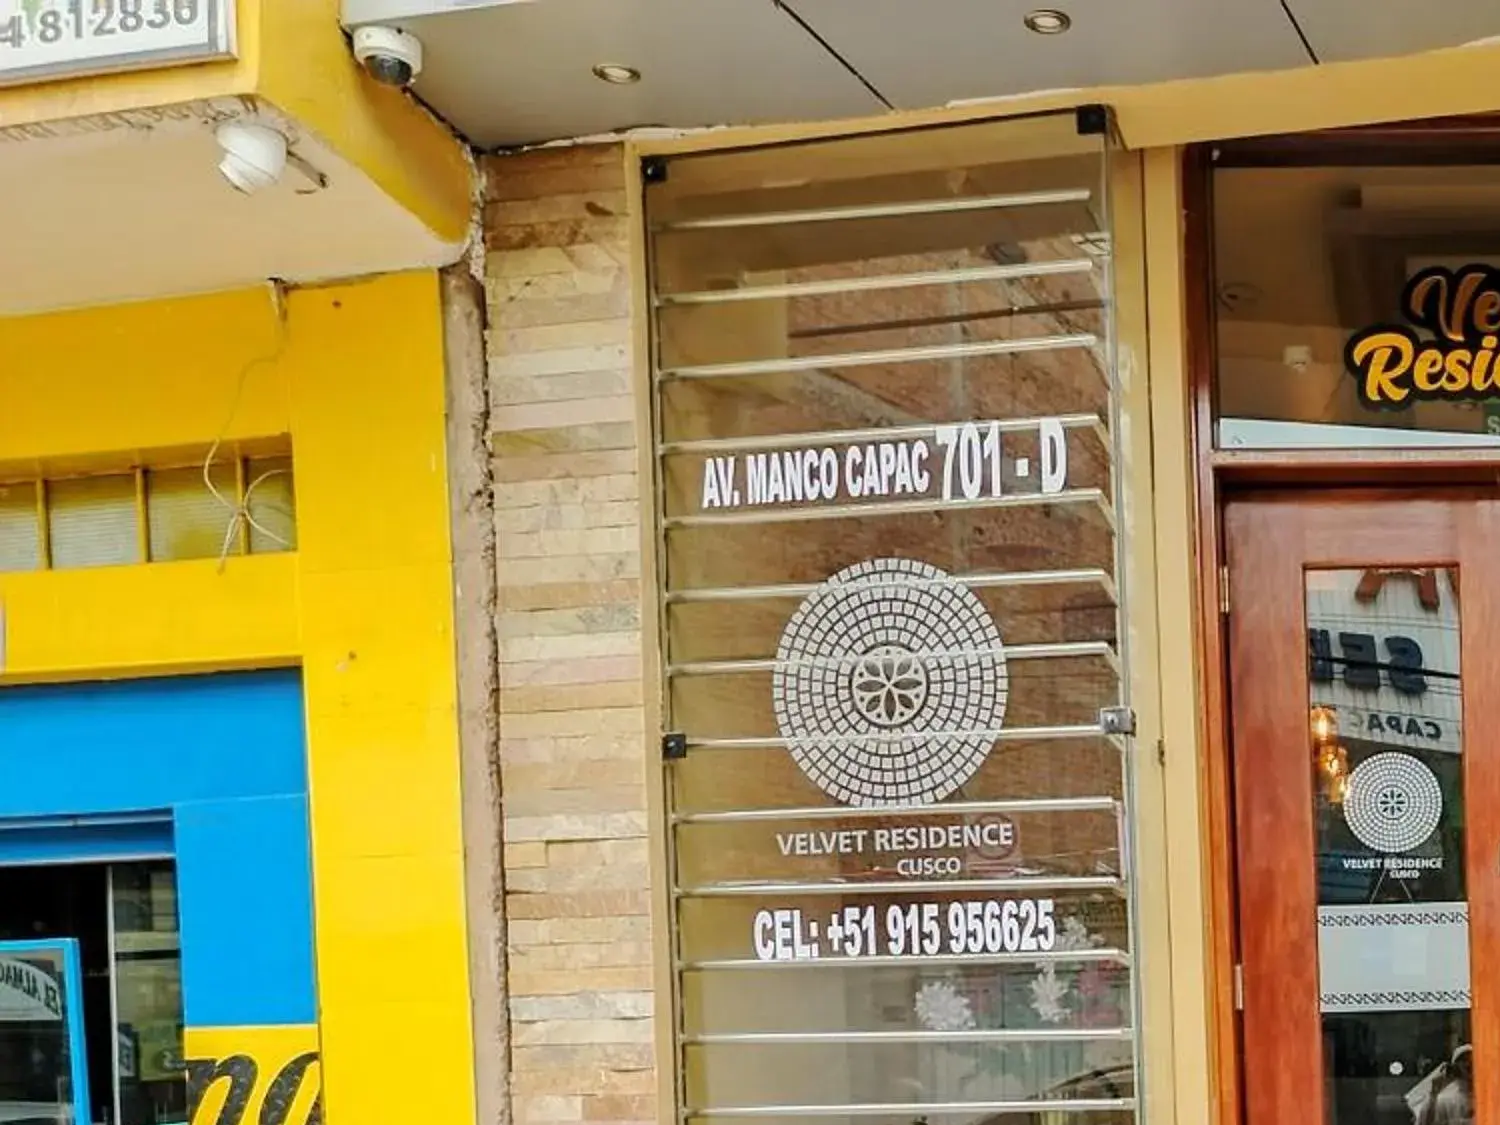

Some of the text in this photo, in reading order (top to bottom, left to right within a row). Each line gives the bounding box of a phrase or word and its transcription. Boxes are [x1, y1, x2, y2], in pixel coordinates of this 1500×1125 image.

[702, 455, 741, 508] AV.
[747, 448, 838, 505] MANCO
[845, 439, 931, 497] CAPAC
[935, 419, 1002, 500] 701
[1039, 417, 1067, 494] D
[776, 823, 1013, 856] VELVET RESIDENCE
[896, 857, 962, 877] CUSCO
[1343, 857, 1443, 869] VELVET RESIDENCE
[1389, 869, 1420, 879] CUSCO
[753, 899, 1056, 961] CEL: +51 915 956625
